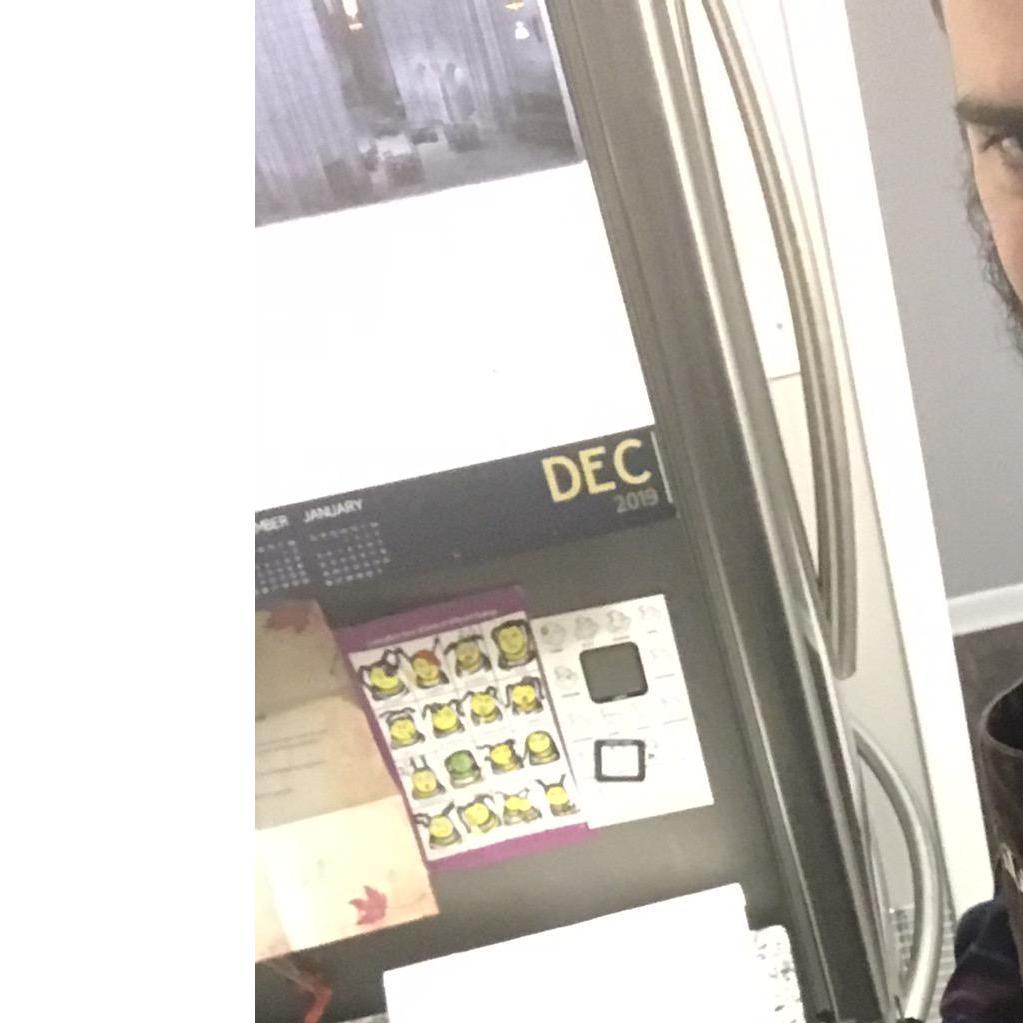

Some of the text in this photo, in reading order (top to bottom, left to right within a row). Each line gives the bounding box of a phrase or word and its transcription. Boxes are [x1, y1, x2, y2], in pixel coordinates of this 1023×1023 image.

[541, 438, 652, 503] DEC
[303, 499, 362, 523] JANUARY
[613, 488, 659, 513] 2019
